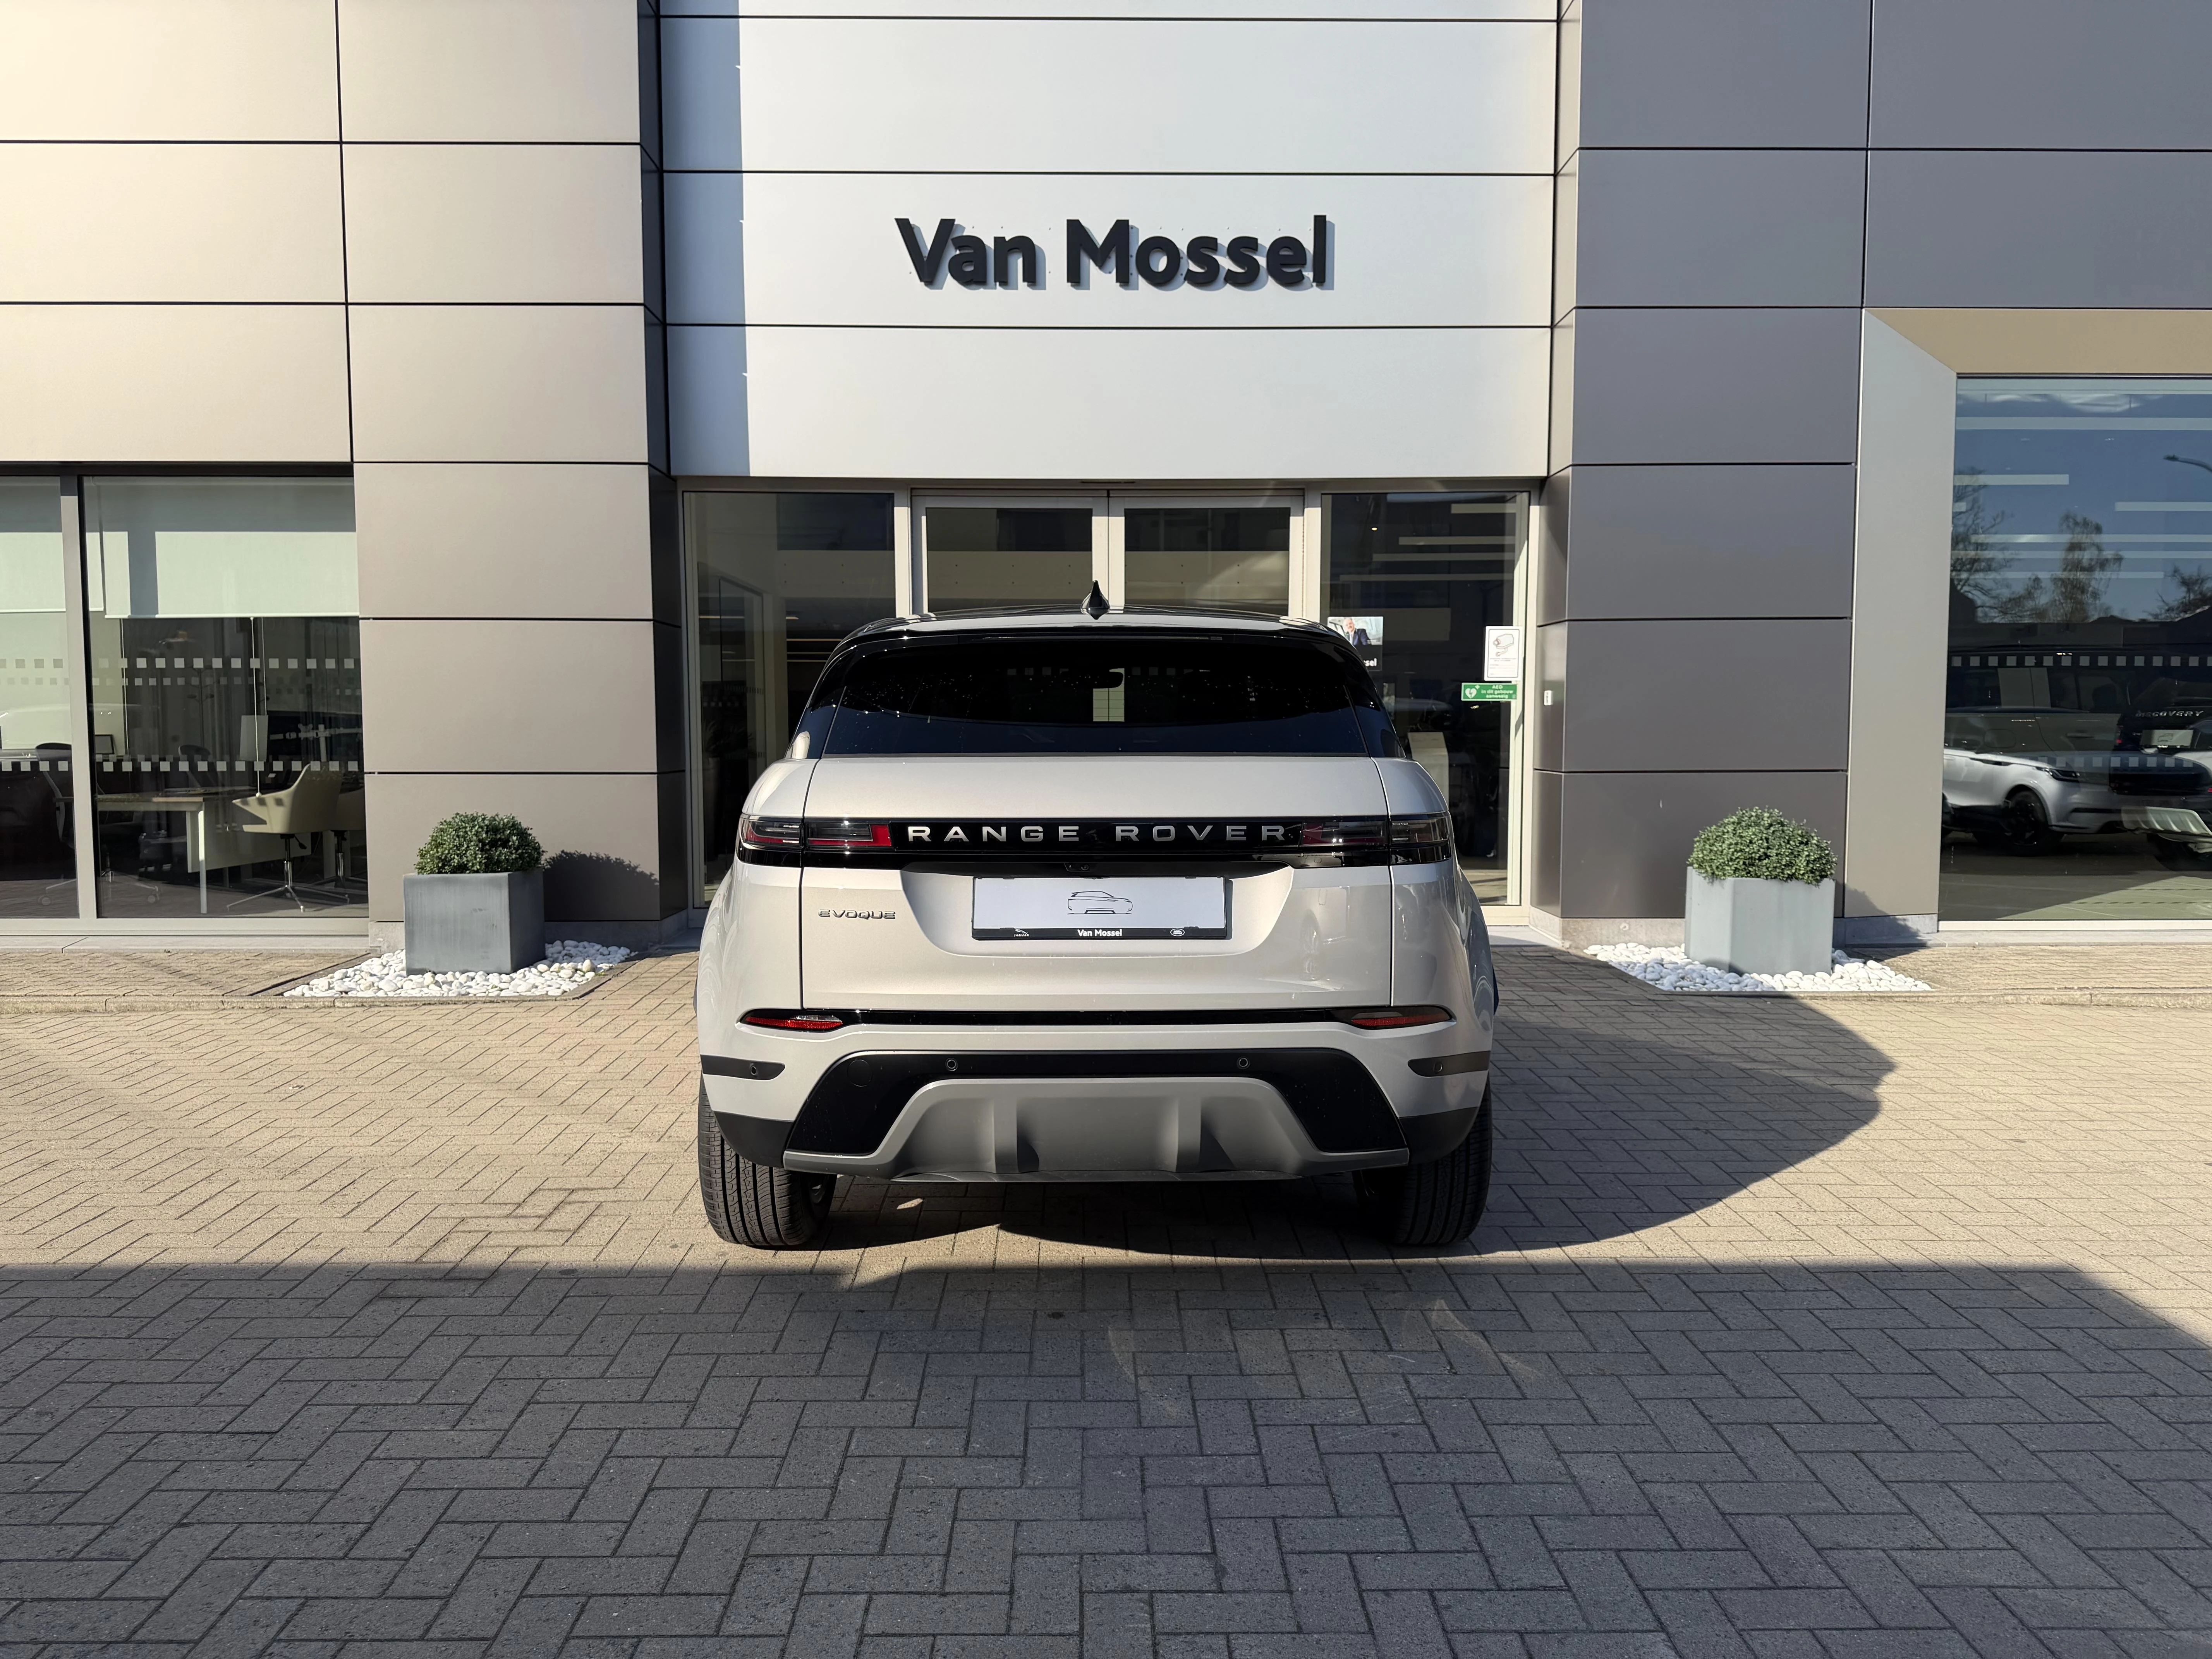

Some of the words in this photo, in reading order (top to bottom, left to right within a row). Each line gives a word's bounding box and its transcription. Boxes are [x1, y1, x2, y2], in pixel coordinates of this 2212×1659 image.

[894, 218, 1037, 284] Van
[1066, 215, 1327, 284] Mossel
[1364, 658, 1377, 666] sel
[908, 826, 1079, 842] RANGE
[1116, 825, 1285, 842] ROVER
[818, 909, 896, 920] EVOQUE
